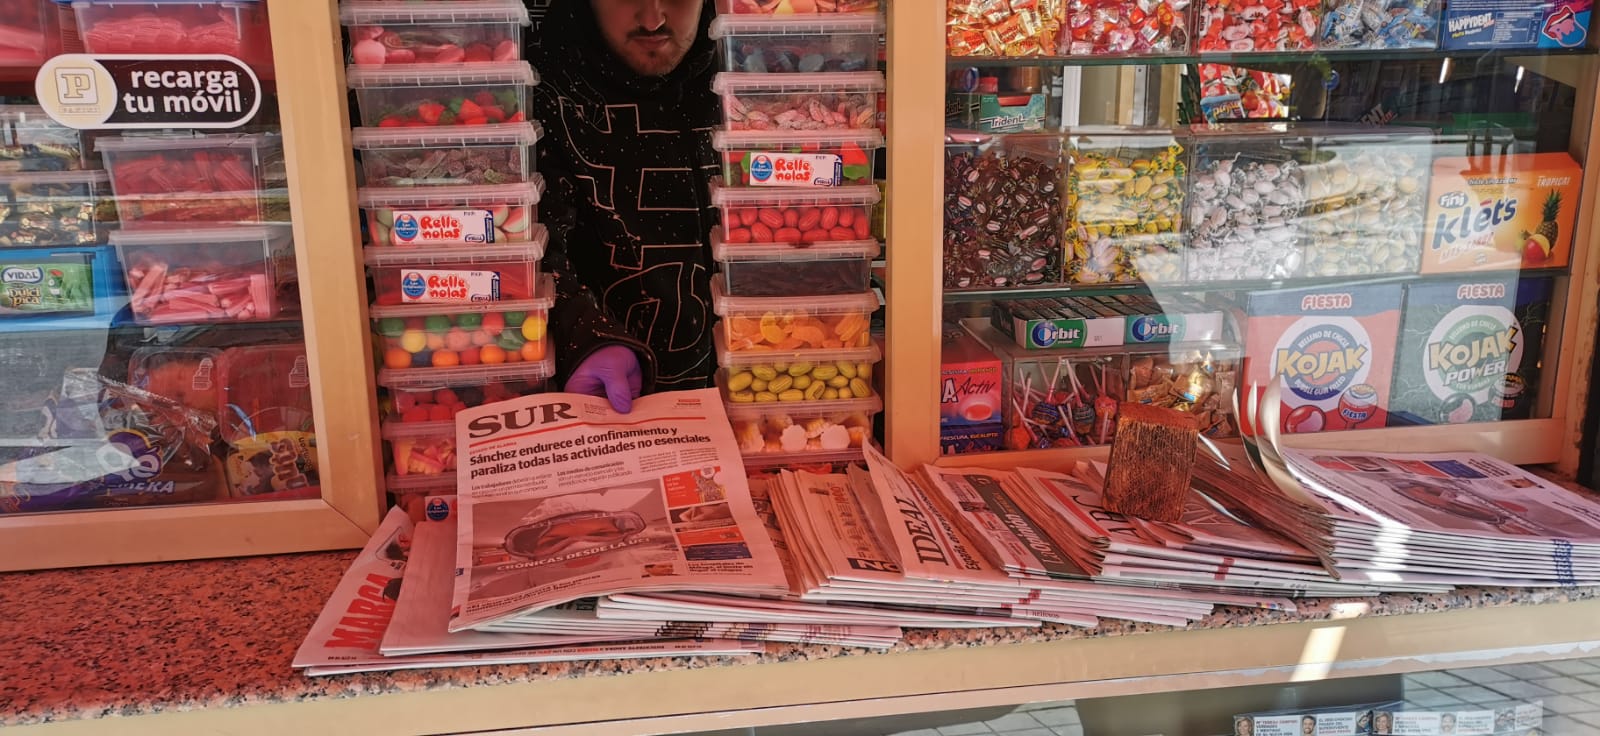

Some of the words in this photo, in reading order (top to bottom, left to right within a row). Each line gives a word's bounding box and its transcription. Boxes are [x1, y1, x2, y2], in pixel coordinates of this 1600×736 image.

[1448, 12, 1492, 32] HAPPYDENT
[61, 73, 90, 98] P
[131, 70, 239, 94] recarga
[123, 92, 155, 113] tu
[164, 90, 242, 113] móvil
[990, 113, 1024, 128] Trident
[775, 158, 809, 171] Relle
[775, 170, 811, 181] nolas
[420, 216, 459, 229] Relle
[423, 229, 461, 238] nolas
[7, 271, 38, 280] VIDAL
[427, 276, 466, 288] Relle
[429, 287, 468, 298] nolas
[1301, 293, 1352, 310] FIESTA
[1457, 284, 1504, 299] FIESTA
[1323, 330, 1332, 338] DE
[1429, 326, 1518, 372] KOJAK
[1277, 344, 1368, 379] KOJAK
[1445, 360, 1506, 385] POWER
[468, 403, 577, 438] SUR
[1342, 408, 1368, 419] FIESTA
[470, 448, 517, 466] Sánchez
[519, 440, 573, 457] endurece
[575, 435, 585, 445] el
[587, 428, 670, 445] confinamiento
[671, 427, 678, 436] y
[470, 462, 517, 480] paraliza
[518, 456, 551, 470] todas
[552, 453, 569, 463] las
[570, 441, 636, 460] actividades
[638, 439, 652, 449] no
[654, 434, 711, 446] esenciales
[894, 495, 950, 566] IDEAL
[497, 555, 563, 571] CRÓNICAS
[566, 546, 607, 560] DESDE
[609, 541, 626, 550] LA
[324, 573, 396, 650] MARCA
